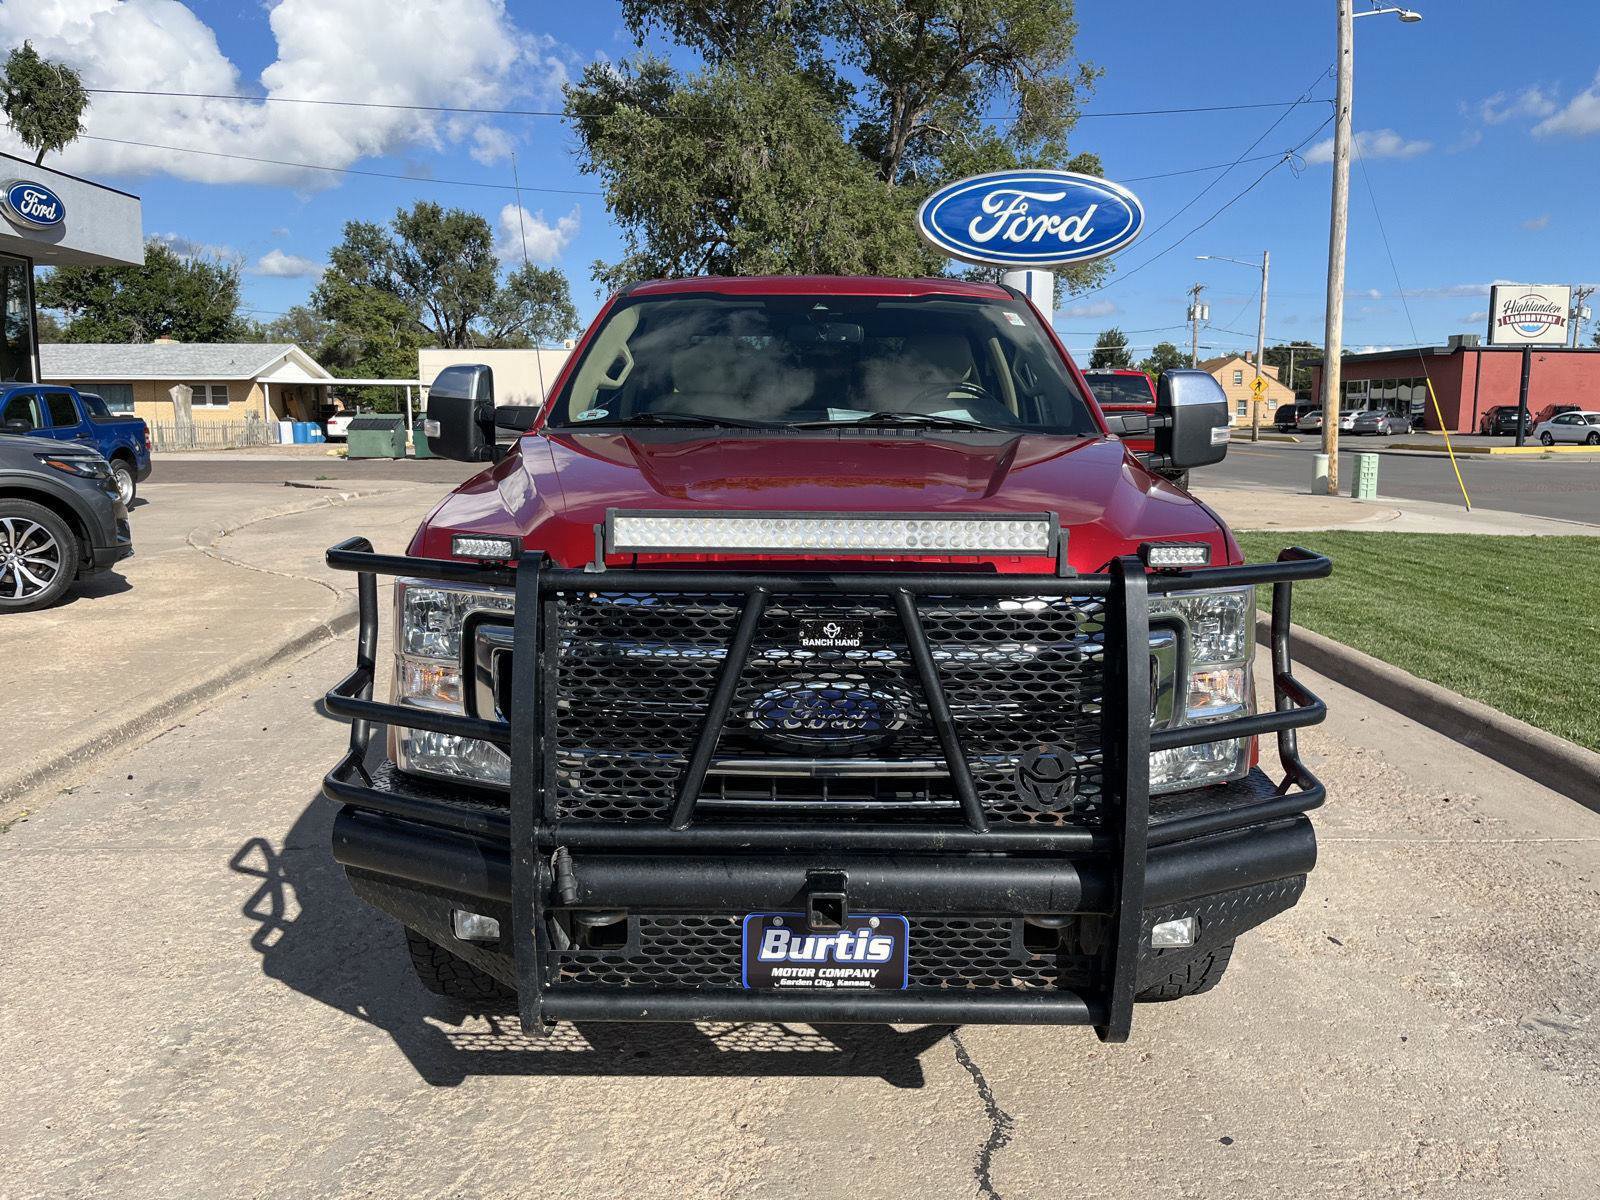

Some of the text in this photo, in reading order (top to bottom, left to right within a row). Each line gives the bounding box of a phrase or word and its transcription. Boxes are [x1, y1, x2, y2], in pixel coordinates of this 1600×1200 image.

[20, 189, 56, 219] Ford
[968, 189, 1098, 243] Ford
[1503, 299, 1561, 315] Highlander
[1506, 314, 1558, 324] LAUNDRYMAT
[802, 638, 860, 646] RANCH HAND
[760, 929, 892, 960] Burtis
[771, 967, 879, 978] MOTOR COMPANY
[780, 978, 870, 987] Garden City, Kansas
